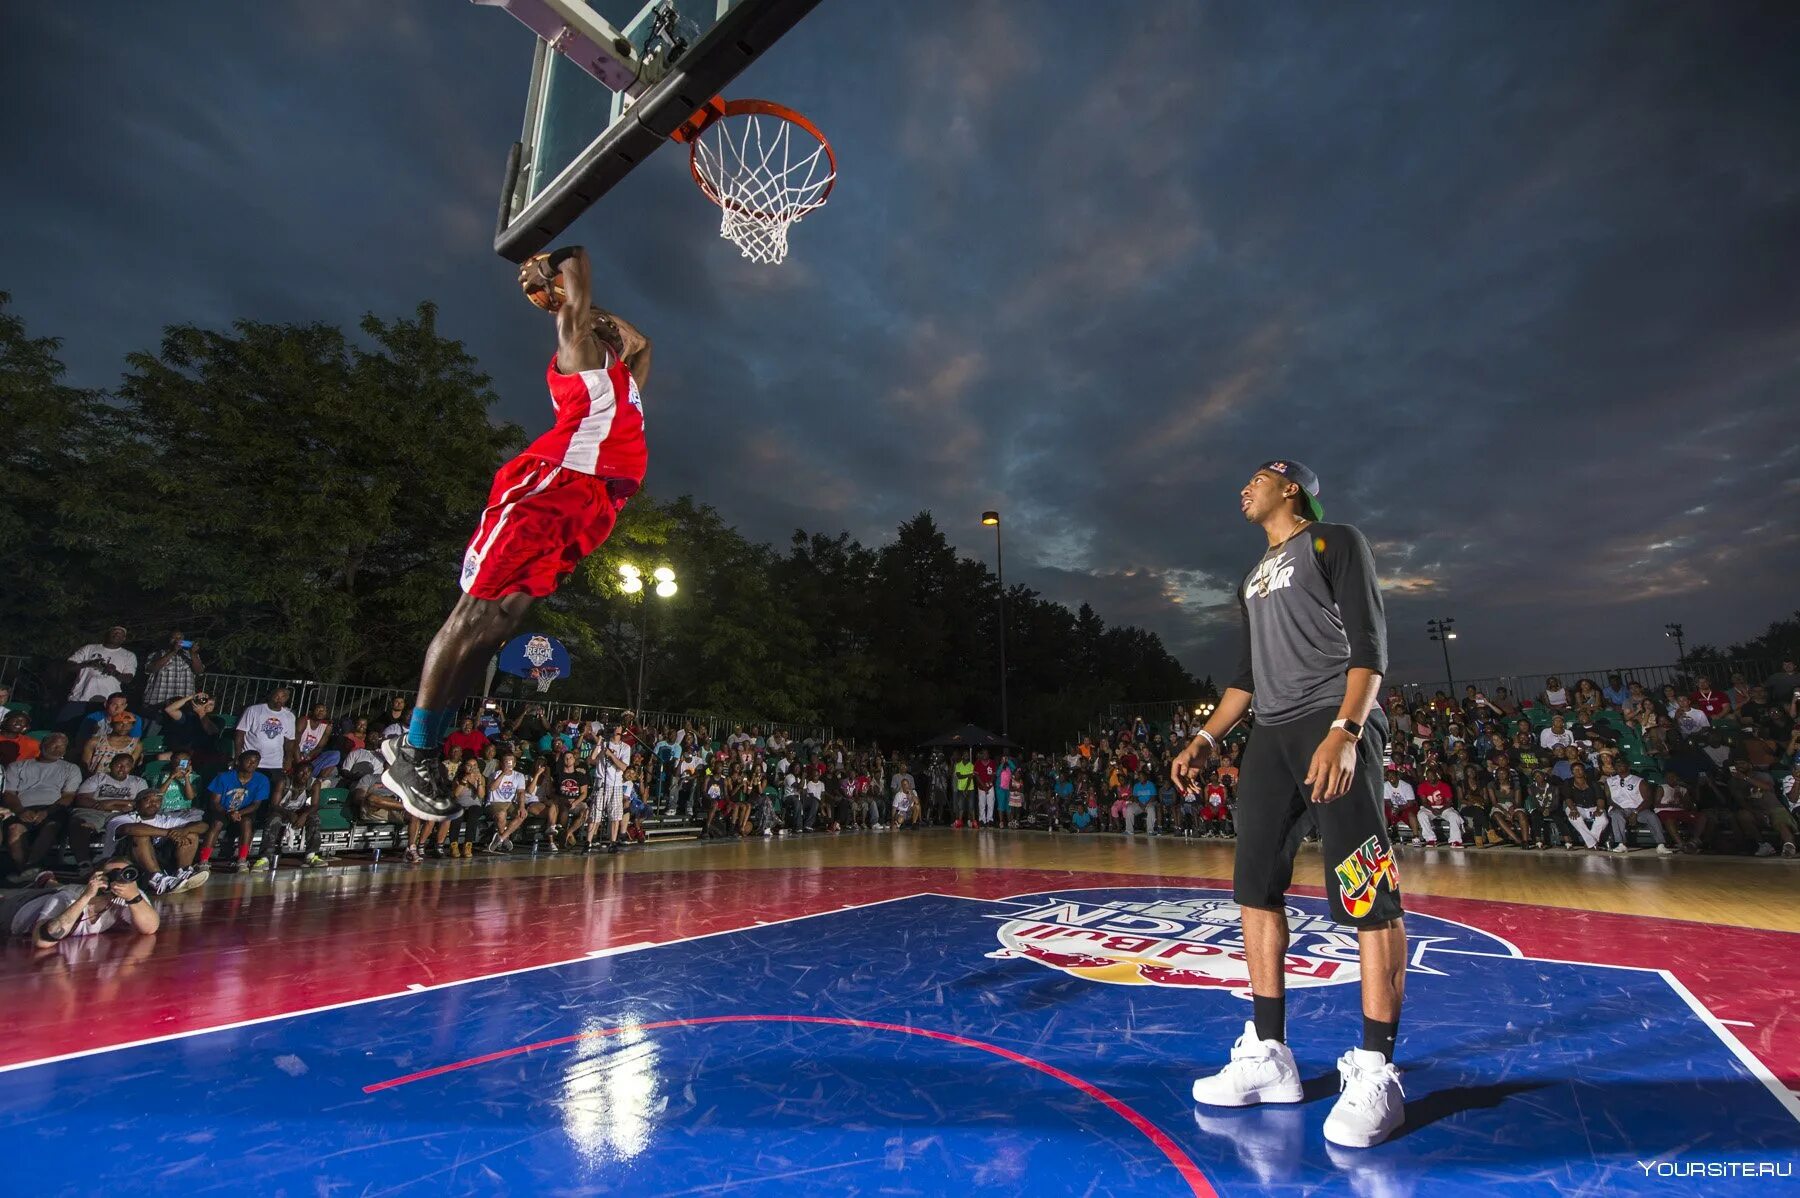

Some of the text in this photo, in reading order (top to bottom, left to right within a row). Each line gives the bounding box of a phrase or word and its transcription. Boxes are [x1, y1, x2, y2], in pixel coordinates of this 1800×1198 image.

[527, 647, 551, 659] REIGN
[1334, 834, 1383, 897] NIKE
[1013, 923, 1164, 953] Bull
